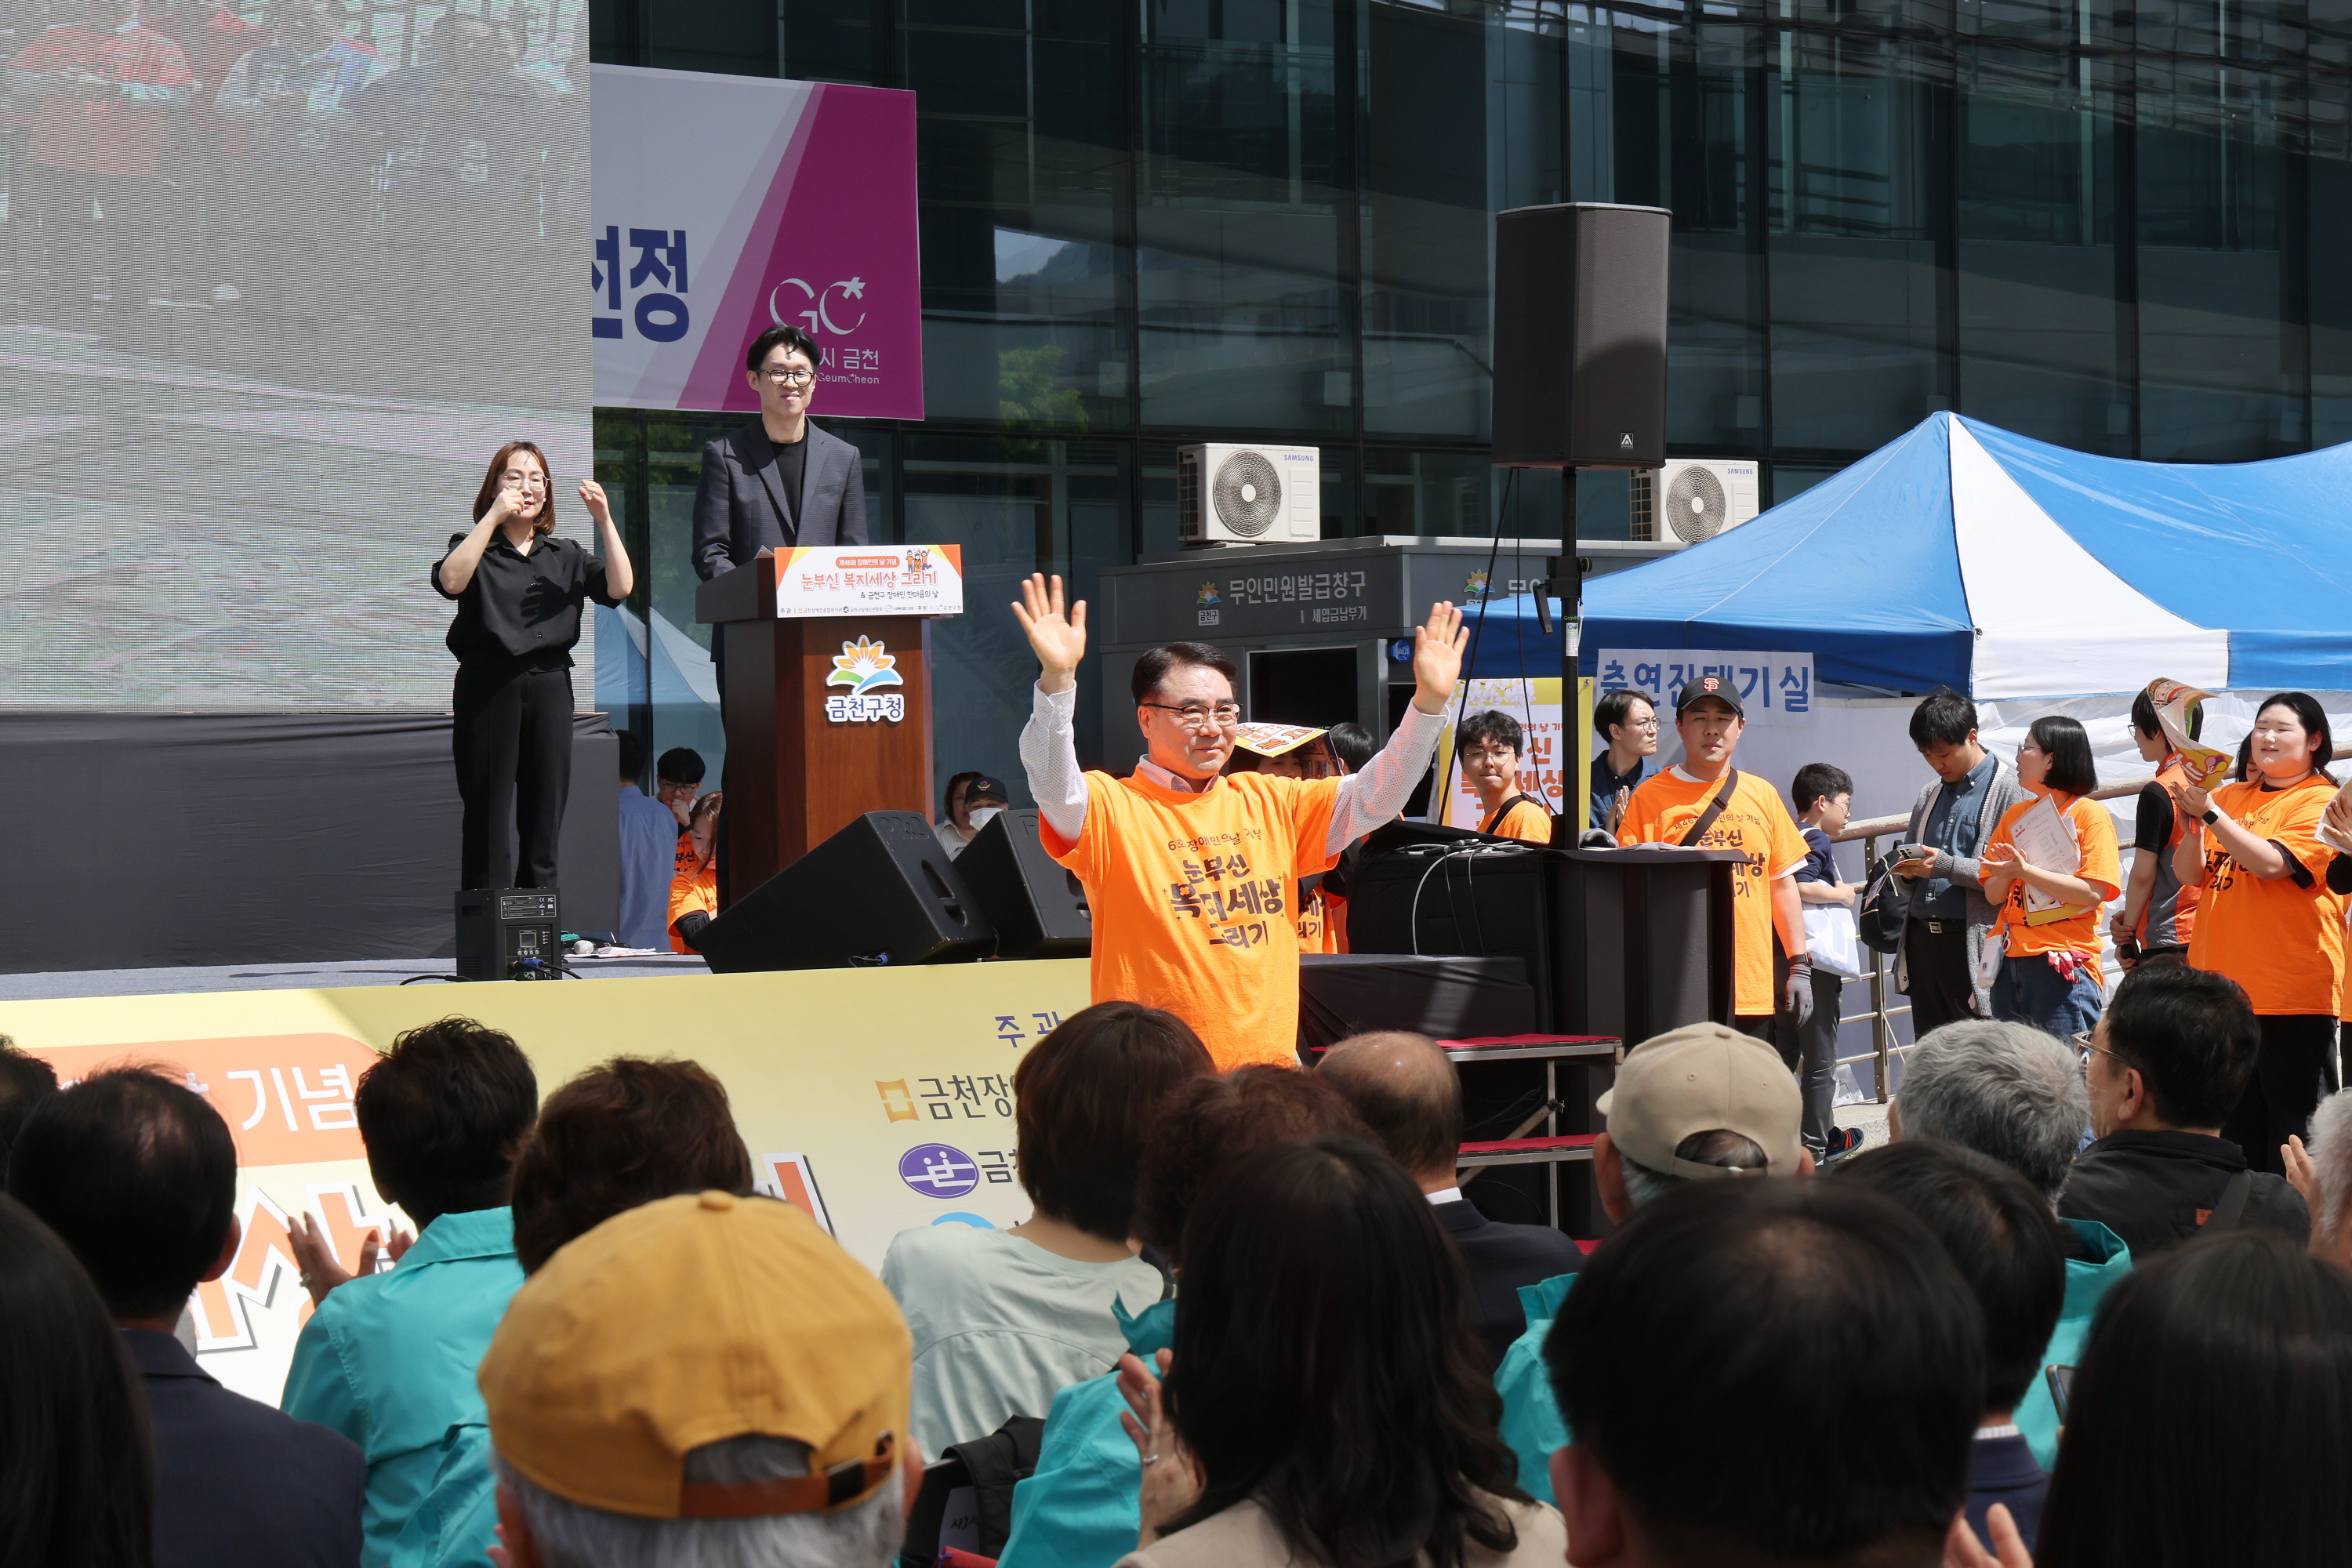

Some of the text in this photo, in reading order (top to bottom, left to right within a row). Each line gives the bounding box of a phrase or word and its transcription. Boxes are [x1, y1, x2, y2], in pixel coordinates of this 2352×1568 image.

[843, 348, 879, 370] 금천
[801, 571, 938, 590] 눈부신 복지세상 그리기
[1229, 571, 1367, 604] 무인민원발급창구
[868, 591, 886, 600] 금천구
[887, 591, 906, 600] 장애인
[907, 590, 931, 599] 한마음의
[1200, 611, 1218, 621] 금천구
[1312, 605, 1367, 623] 세입금납부기
[829, 697, 902, 719] 금천구청
[1182, 854, 1251, 884] 눈부신
[1209, 920, 1269, 949] 그리기
[226, 1063, 359, 1132] 기념
[918, 1073, 1018, 1120] 금천장
